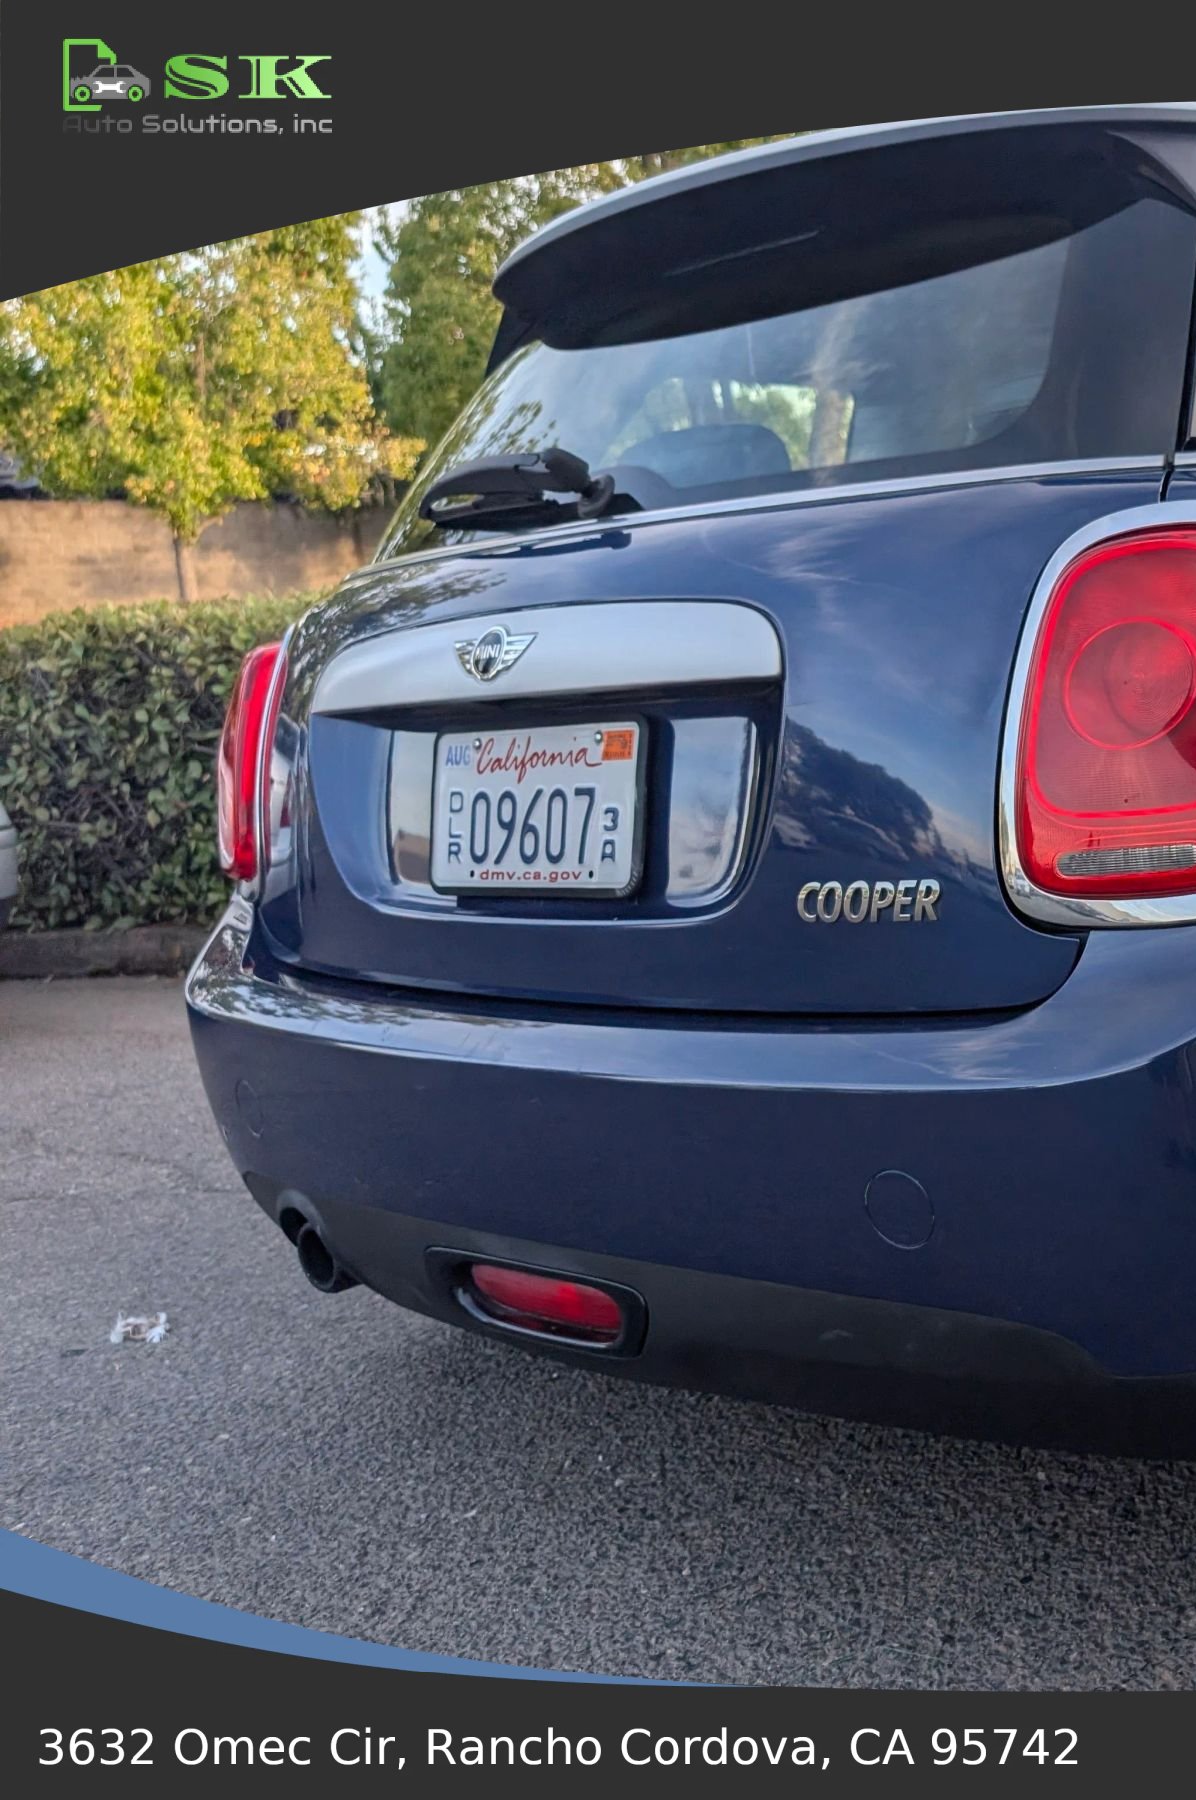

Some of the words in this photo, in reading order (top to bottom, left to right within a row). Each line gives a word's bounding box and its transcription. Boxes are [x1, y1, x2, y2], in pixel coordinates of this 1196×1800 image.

[446, 746, 470, 766] AUG
[477, 736, 602, 784] California
[470, 787, 596, 865] 09607
[479, 869, 582, 883] dmv.ca.gov
[796, 878, 941, 923] COOPER
